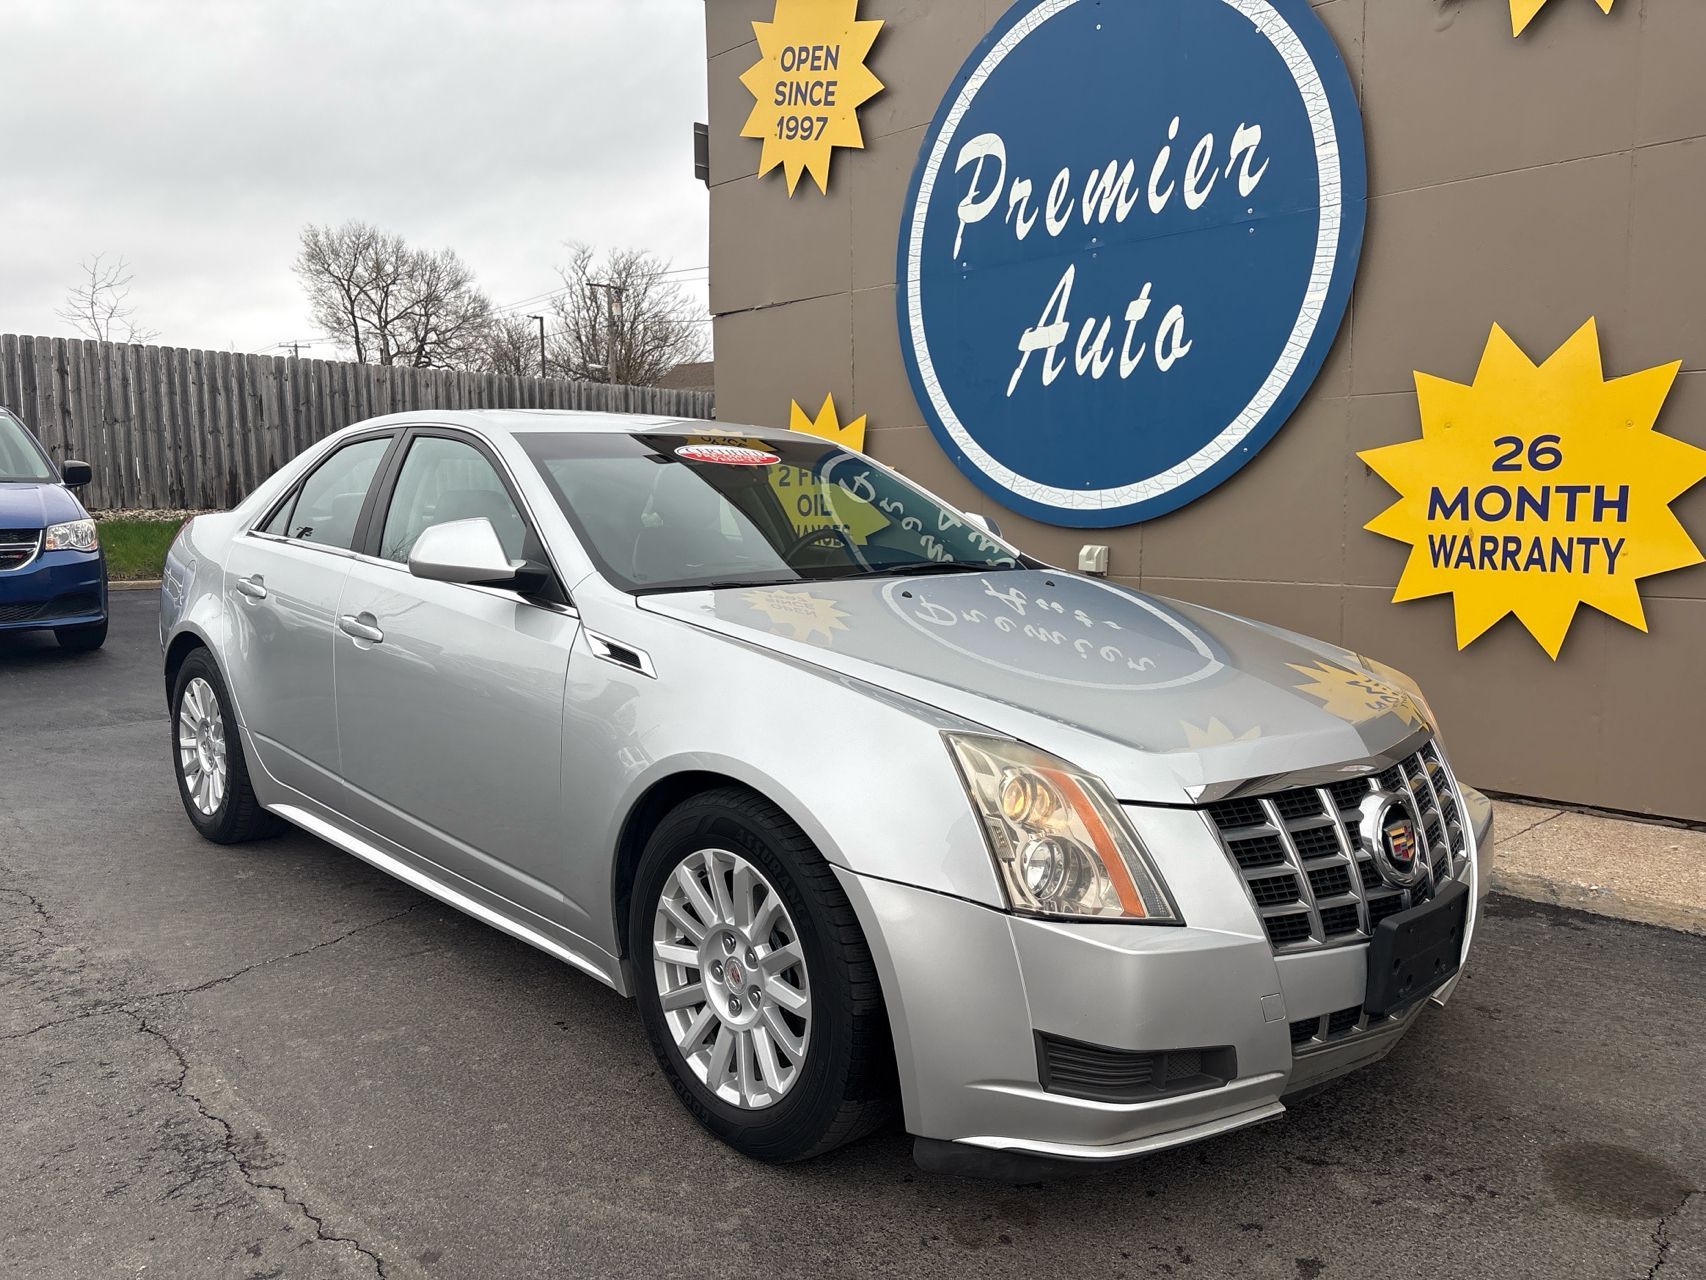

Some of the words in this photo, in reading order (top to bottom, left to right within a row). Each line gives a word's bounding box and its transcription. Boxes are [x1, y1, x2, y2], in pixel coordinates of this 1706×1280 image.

[780, 45, 840, 73] OPEN
[774, 80, 838, 107] SINCE
[777, 115, 829, 141] 1997
[953, 115, 1270, 260] Premier
[1006, 263, 1193, 397] Auto
[1491, 434, 1563, 472] 26
[778, 466, 791, 487] 2
[797, 493, 833, 517] OIL
[1427, 484, 1630, 523] MONTH
[1427, 534, 1626, 575] WARRANTY
